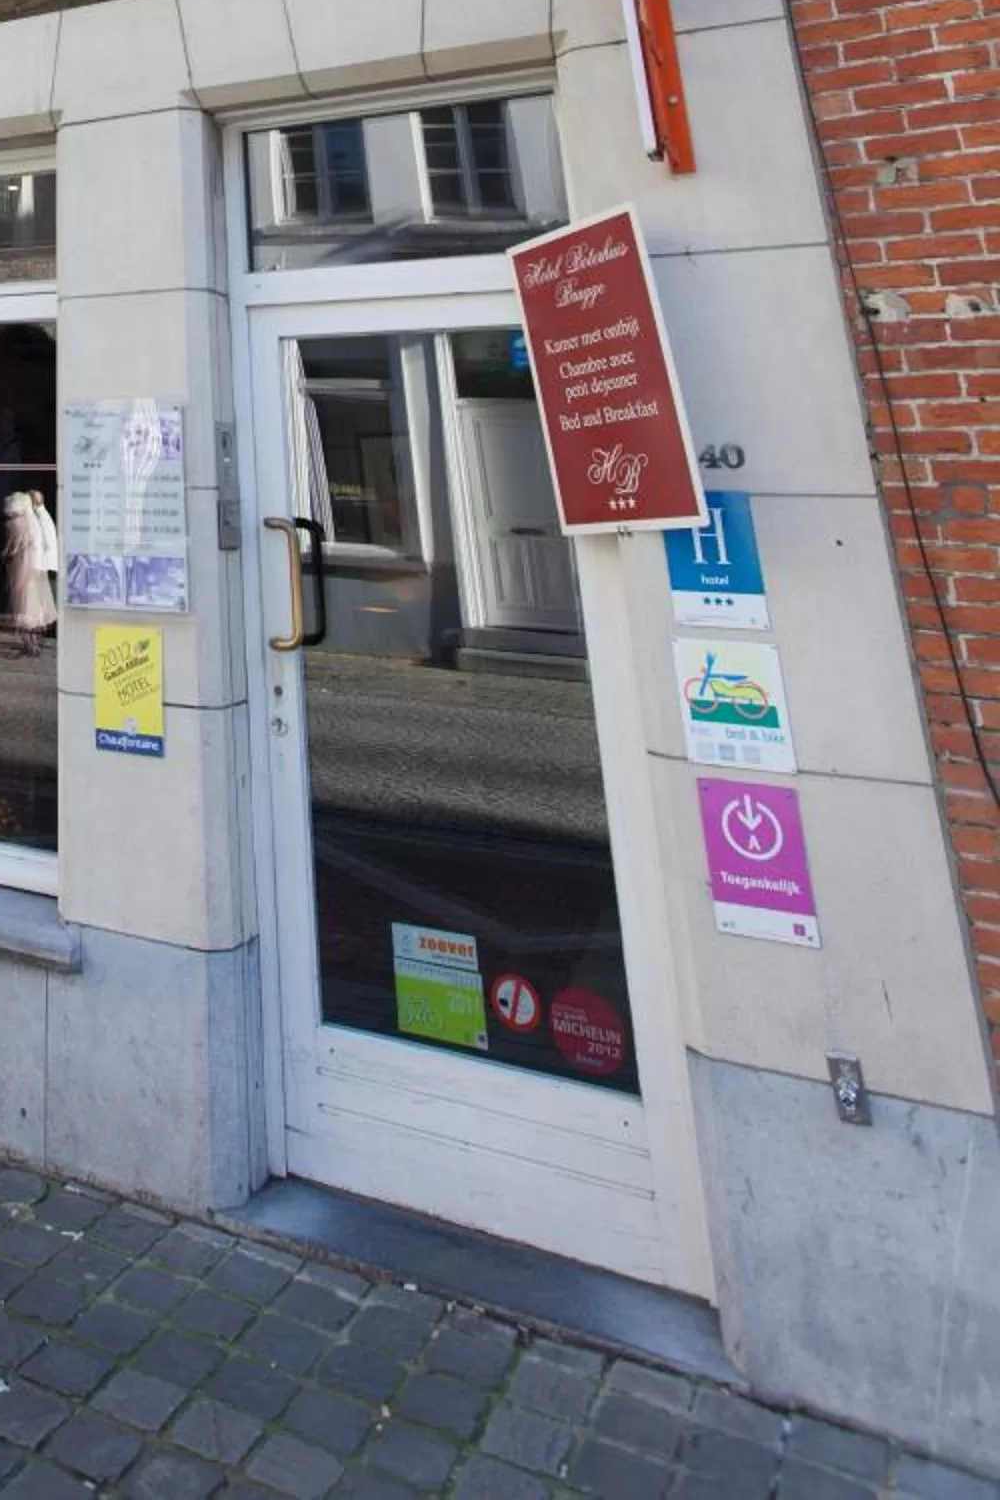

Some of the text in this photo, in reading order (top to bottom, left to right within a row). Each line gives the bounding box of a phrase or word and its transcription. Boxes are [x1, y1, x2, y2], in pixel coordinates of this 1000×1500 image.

[523, 235, 629, 289] Hotel Boterhuis
[544, 315, 640, 355] Kamer met ontbijt
[560, 351, 635, 378] Chambre avec
[565, 380, 588, 404] petit
[559, 400, 658, 431] Bed and Breakfast
[698, 443, 745, 470] 40
[701, 573, 729, 585] hotel
[720, 871, 801, 896] Toegankelijk
[552, 1019, 621, 1045] MICHELIN
